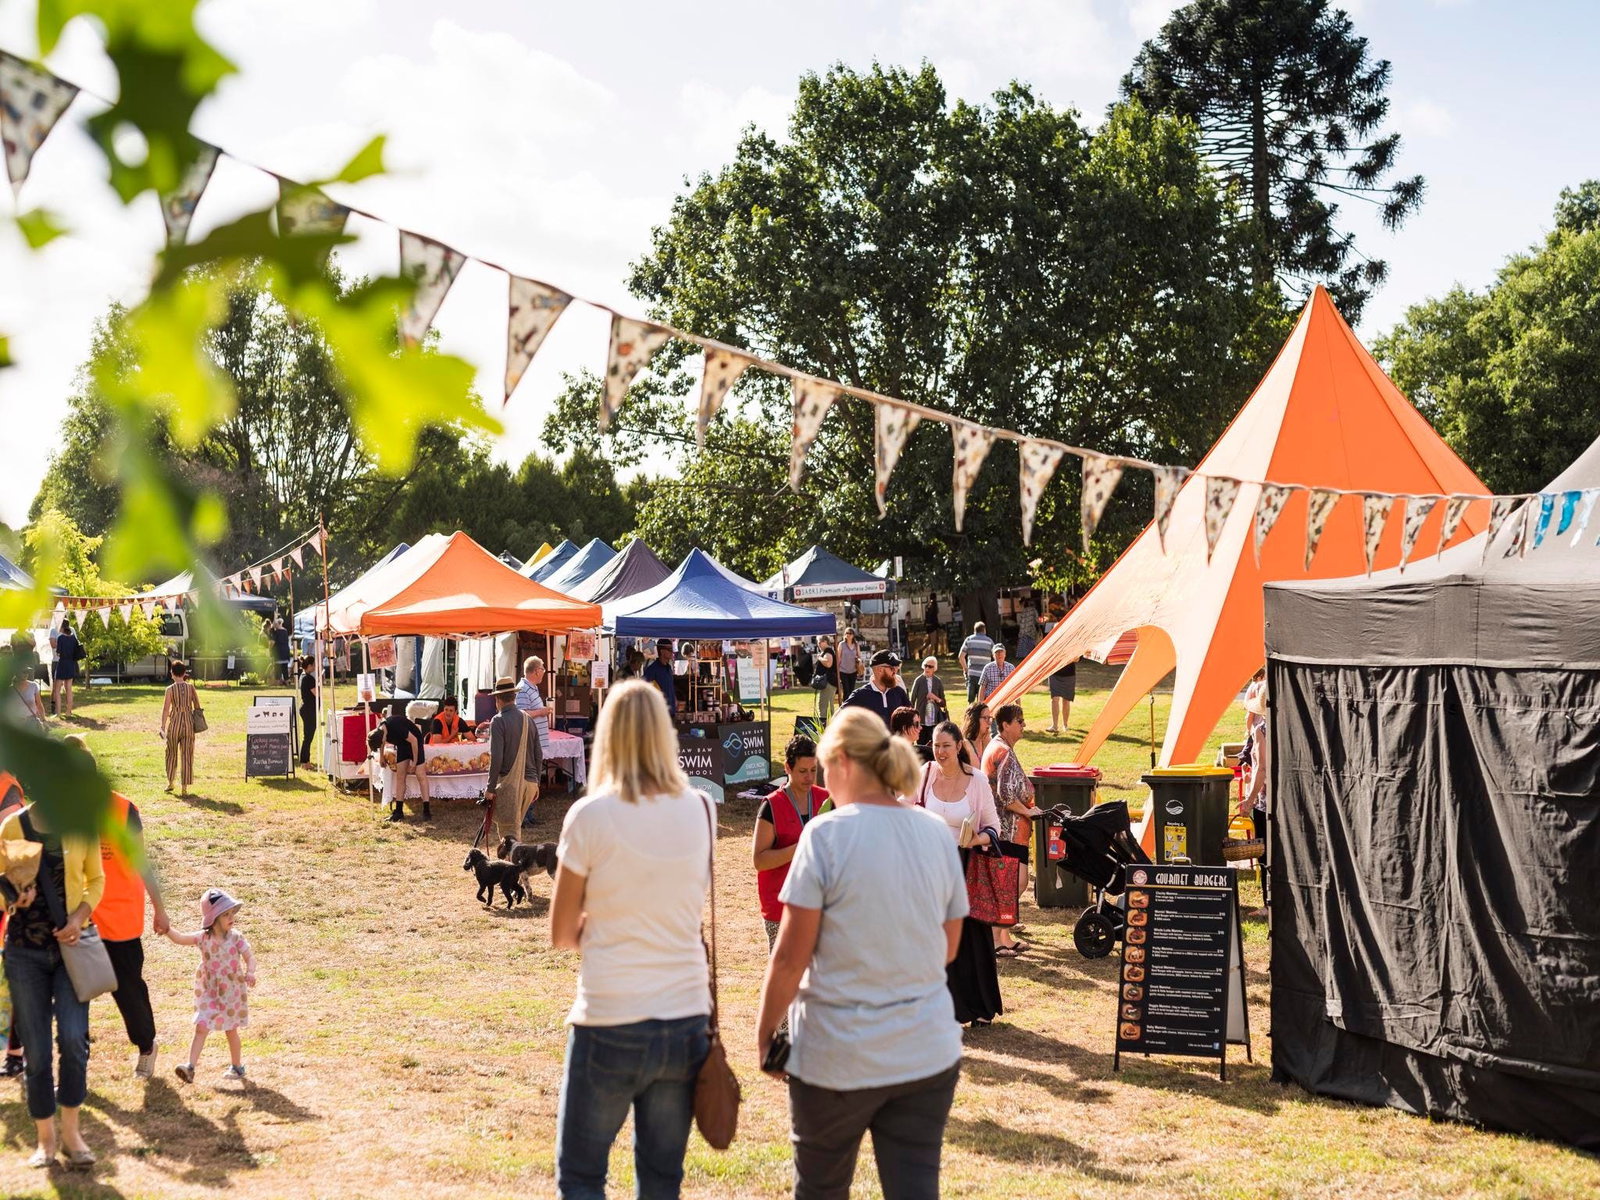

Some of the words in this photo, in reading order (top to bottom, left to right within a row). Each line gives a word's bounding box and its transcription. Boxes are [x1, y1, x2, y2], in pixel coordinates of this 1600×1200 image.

[820, 586, 841, 594] Premium
[743, 736, 765, 749] SWIM
[678, 755, 713, 768] SWIM
[1155, 872, 1189, 886] GOURMET
[1193, 874, 1228, 887] BURGERS
